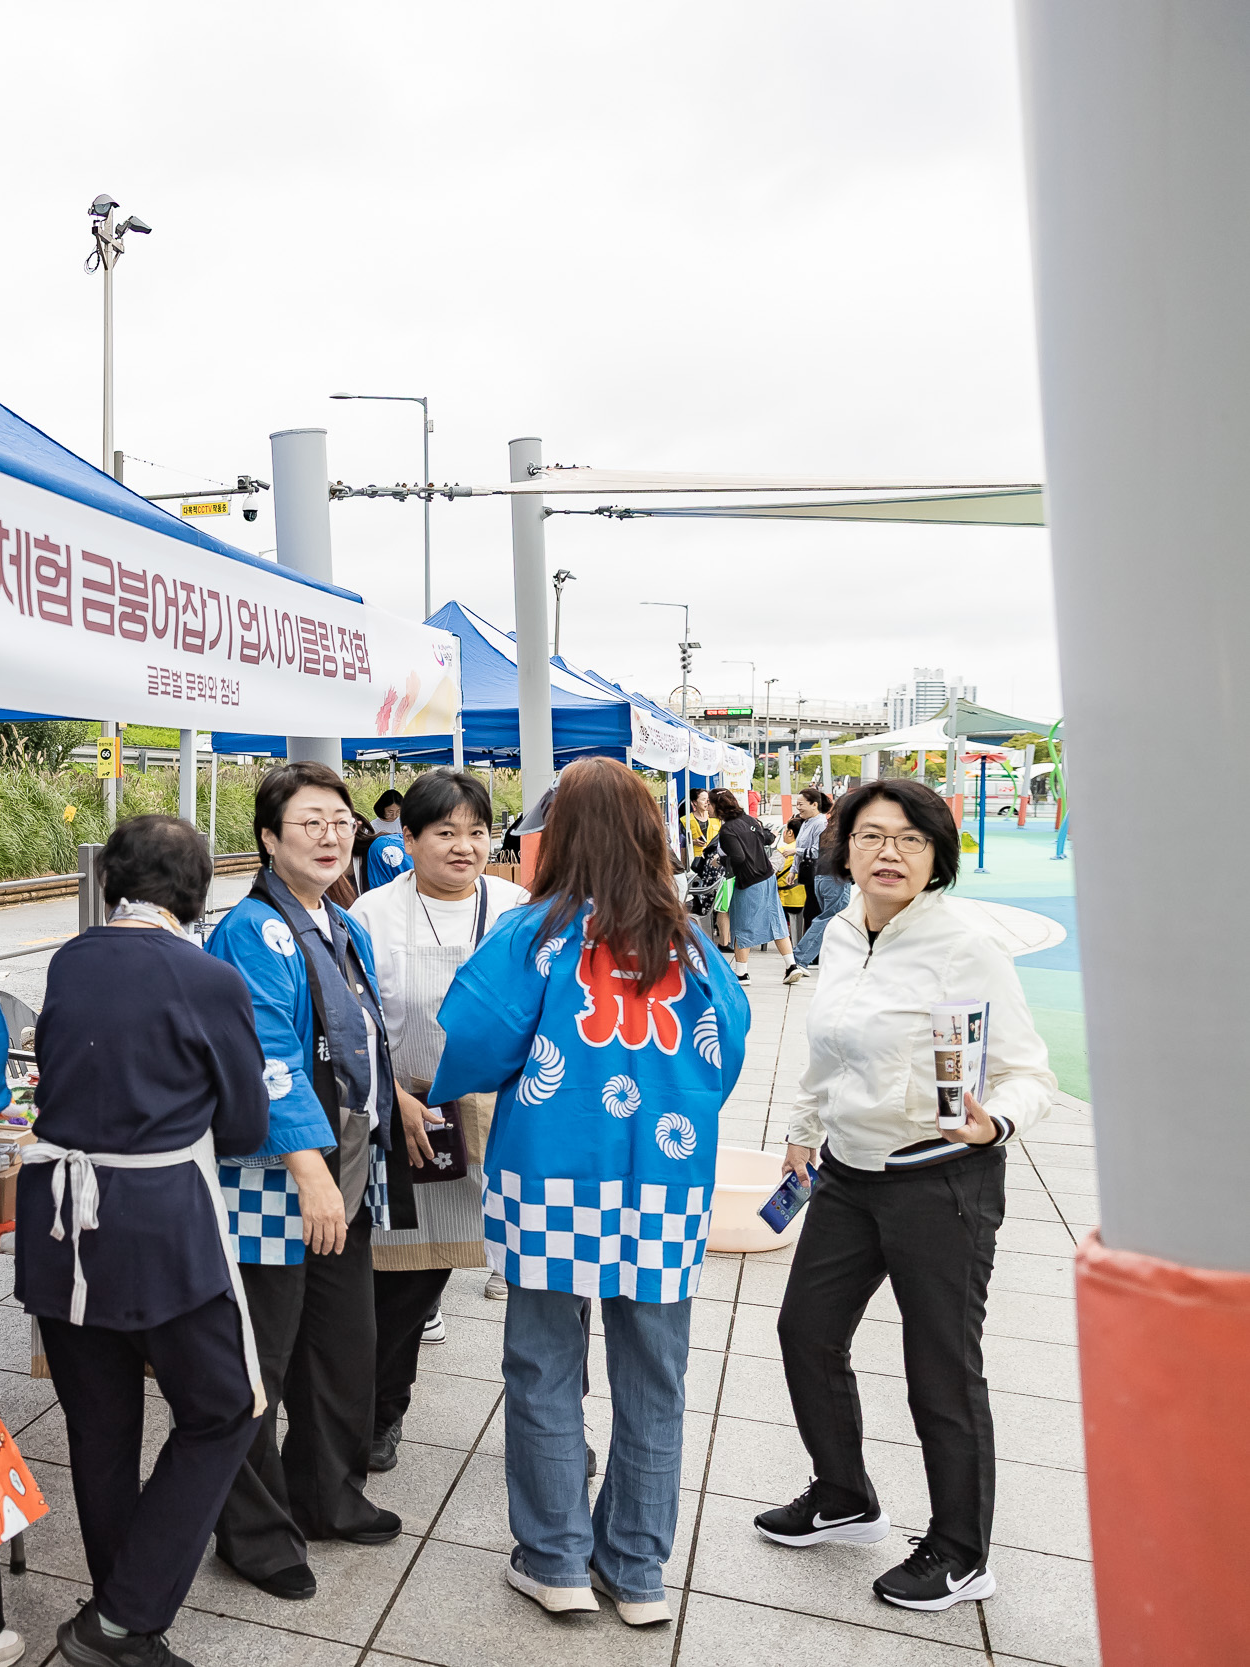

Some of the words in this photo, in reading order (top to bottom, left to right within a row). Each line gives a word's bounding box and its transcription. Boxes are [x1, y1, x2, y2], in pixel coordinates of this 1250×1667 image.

[81, 549, 233, 660] 금붕어잡기
[238, 599, 337, 678] 업사이클링
[337, 626, 371, 683] 잡화
[147, 665, 182, 699] 글로벌
[185, 672, 217, 704] 문화와
[220, 677, 239, 706] 청년
[101, 750, 111, 758] 66
